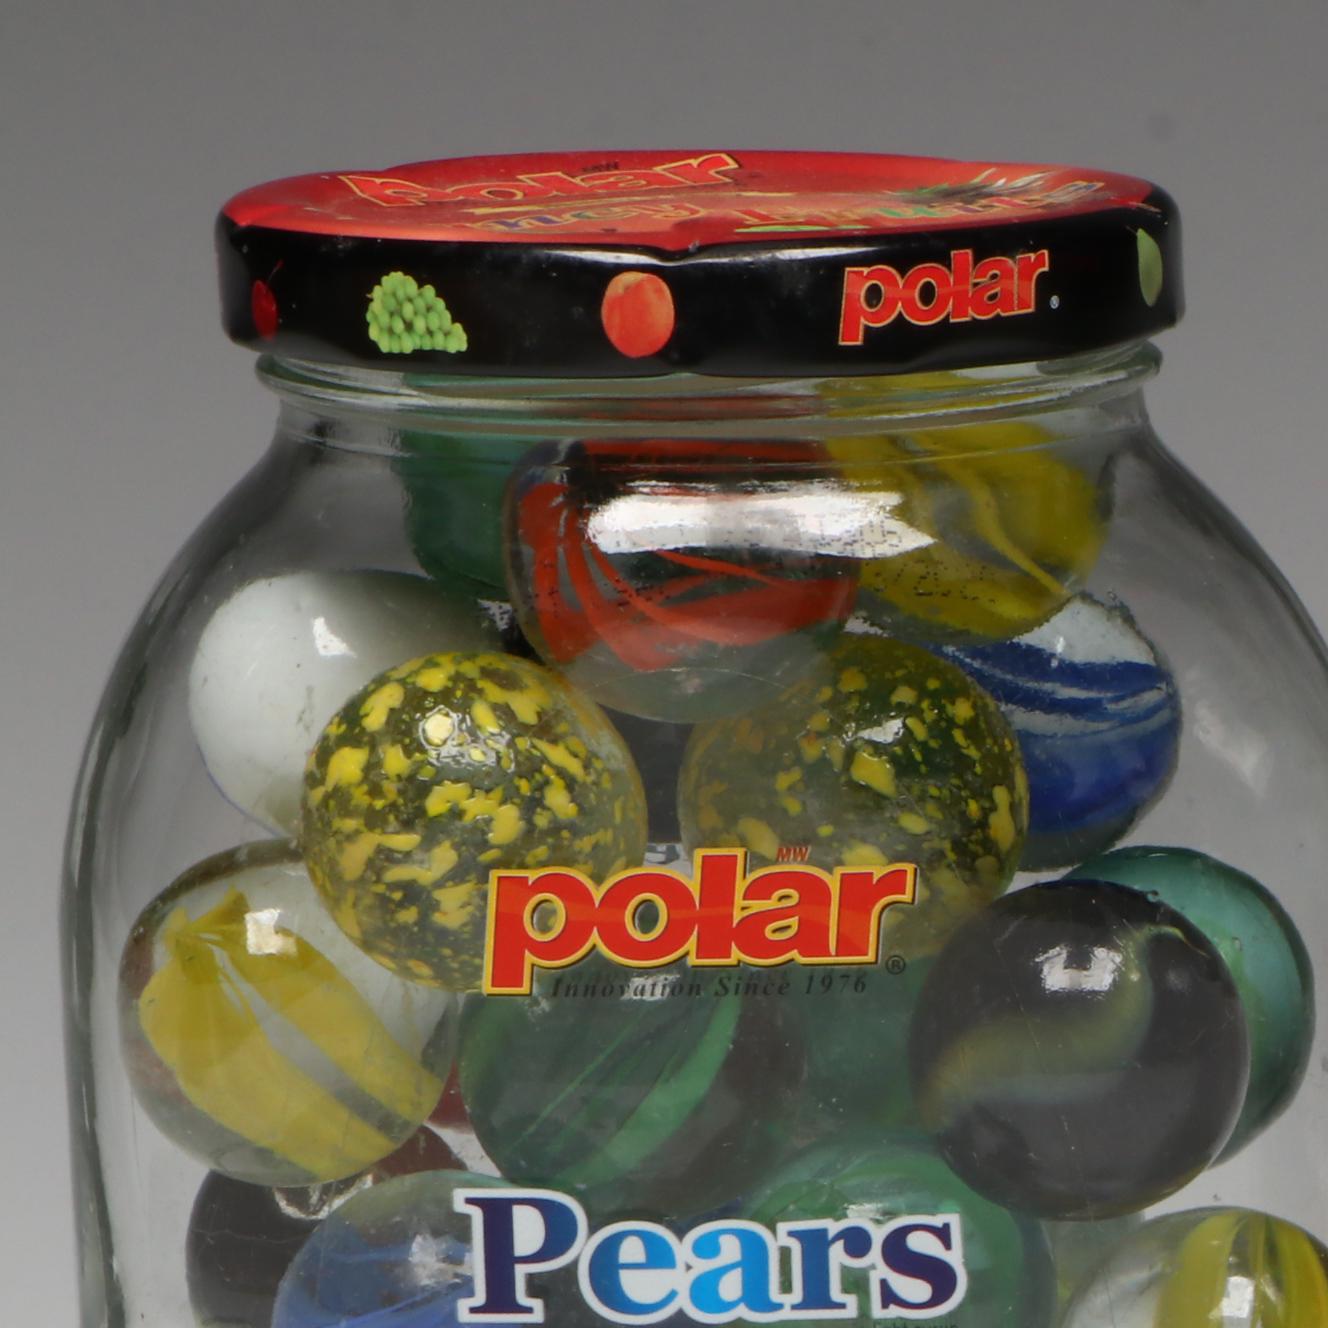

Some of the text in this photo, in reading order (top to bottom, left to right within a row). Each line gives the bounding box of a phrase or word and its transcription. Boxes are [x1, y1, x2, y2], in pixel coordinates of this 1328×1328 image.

[338, 152, 739, 207] polar
[838, 249, 1049, 346] polar
[775, 846, 810, 863] MW
[483, 847, 918, 997] polar
[550, 974, 867, 999] Innovation Since 1976
[453, 1188, 968, 1324] Pears
